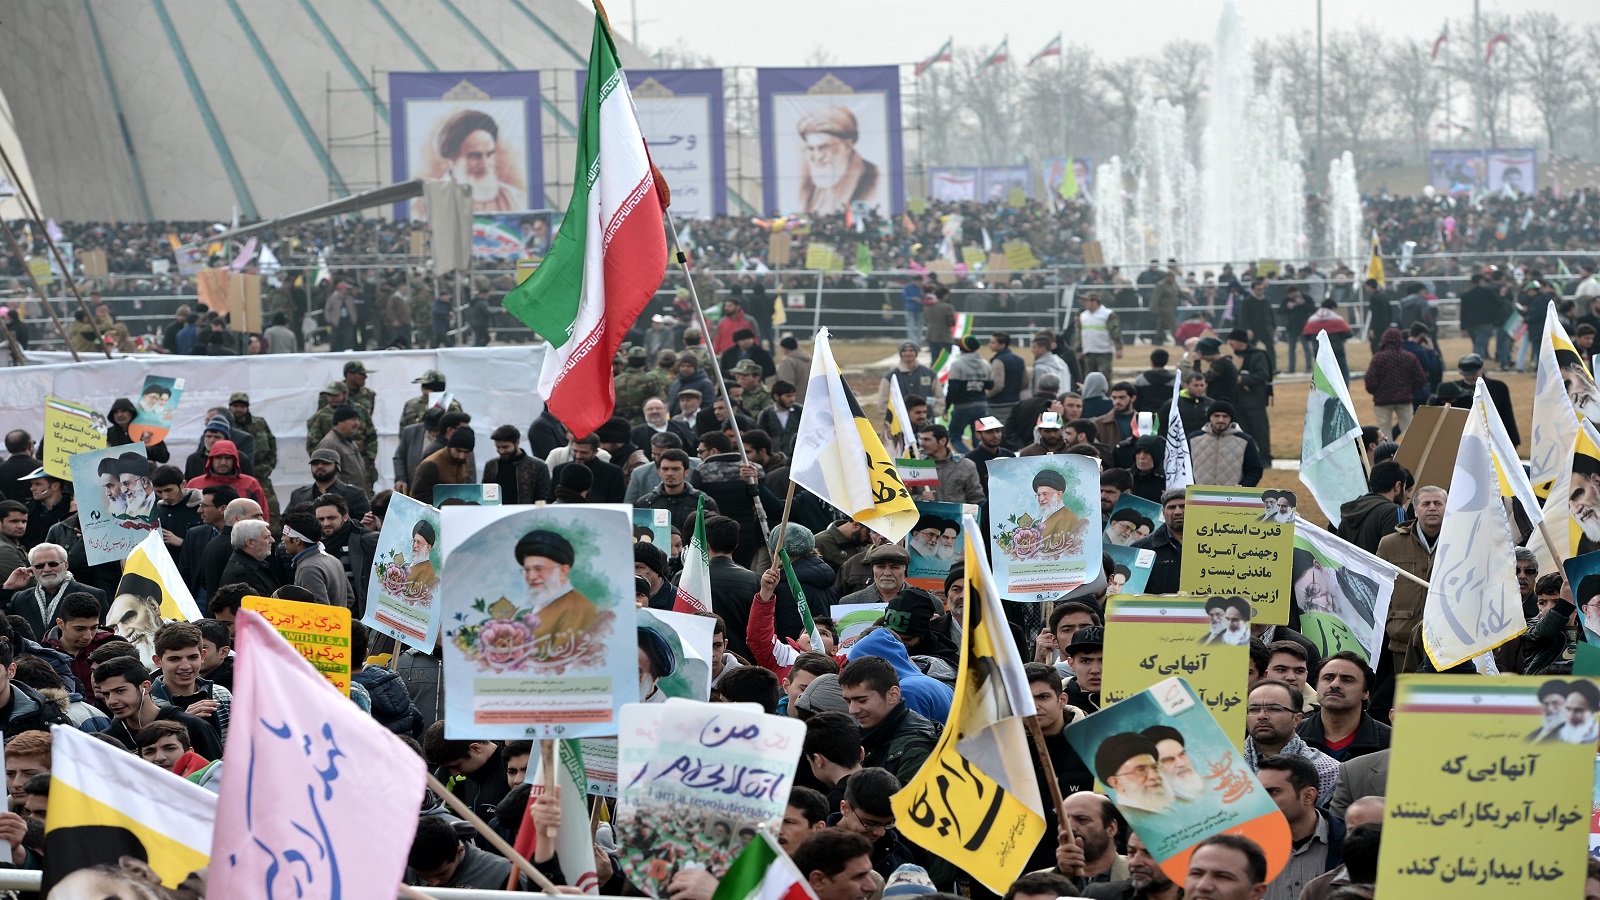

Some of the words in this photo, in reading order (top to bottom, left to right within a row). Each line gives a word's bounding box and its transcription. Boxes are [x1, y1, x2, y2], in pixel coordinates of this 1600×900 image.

[53, 421, 84, 433] استکباری
[54, 432, 78, 444] آمریکا
[84, 430, 100, 440] قدرت
[1196, 522, 1248, 536] استکباری
[1249, 524, 1282, 539] قدرت
[1197, 543, 1238, 558] آمریکا
[1237, 548, 1272, 560] جهنمی
[1200, 568, 1206, 578] و
[1208, 565, 1235, 578] نیست
[1237, 566, 1272, 580] ماندنی
[1251, 590, 1269, 602] بین
[1269, 590, 1279, 603] از
[299, 620, 310, 629] بر
[314, 617, 341, 631] مرگ
[286, 632, 312, 641] WITH
[316, 636, 344, 645] U.S.A
[318, 646, 344, 660] مرگ
[1140, 654, 1158, 670] که
[1158, 653, 1210, 675] آنهایی
[1207, 691, 1242, 712] خواب
[700, 714, 760, 747] من
[1442, 755, 1468, 774] که
[1468, 754, 1541, 782] آنهایی
[648, 787, 652, 796] I
[655, 790, 675, 801] am
[678, 796, 686, 804] a
[690, 796, 775, 819] revolutionary
[1460, 801, 1474, 827] را
[1476, 801, 1534, 829] آمریکا
[1534, 805, 1583, 831] خواب
[1398, 856, 1440, 875] کند.
[1528, 860, 1564, 881] خدا
